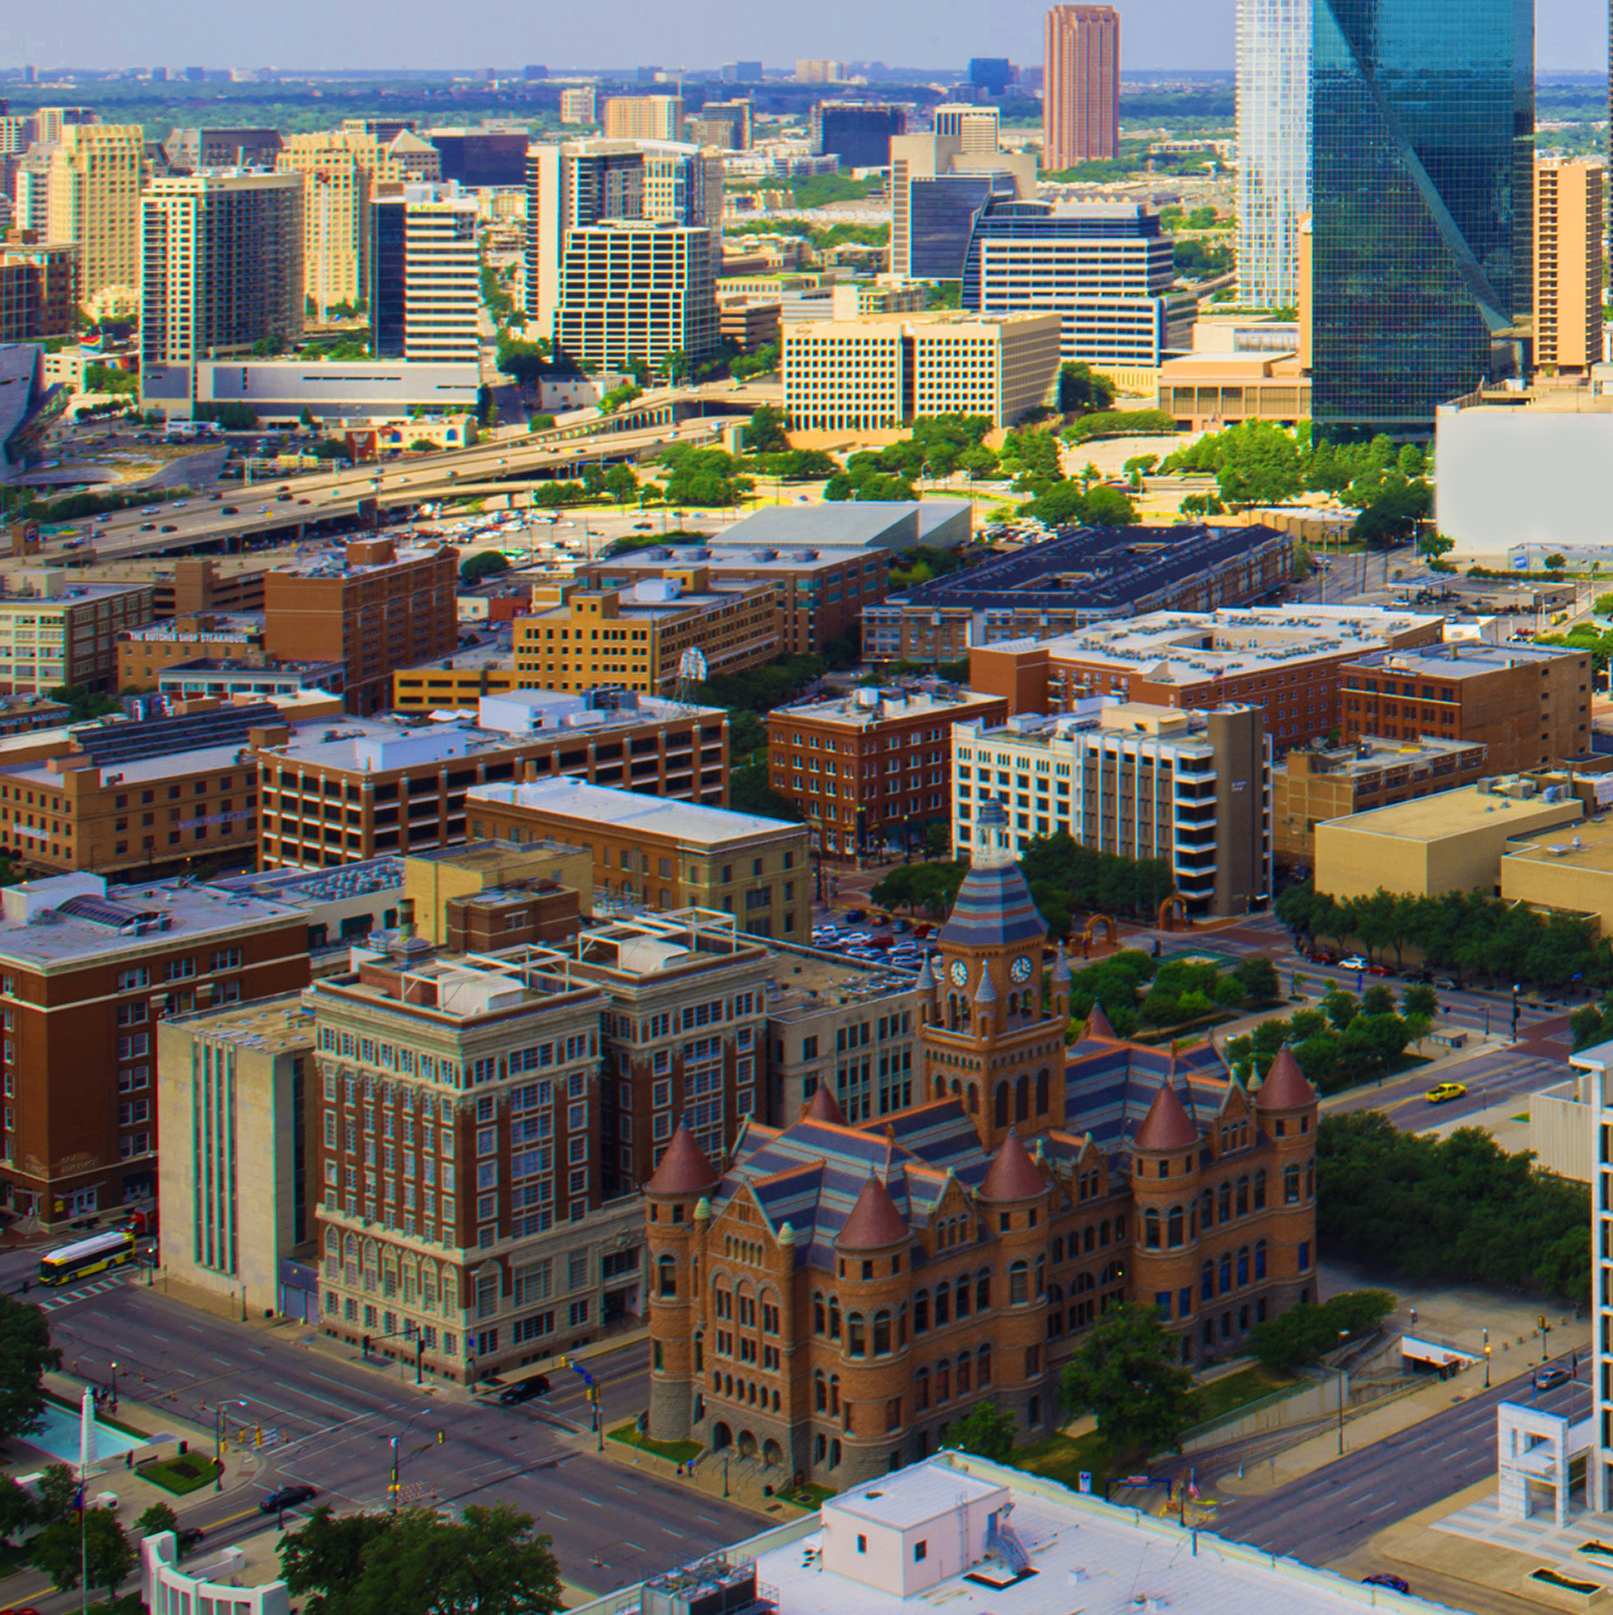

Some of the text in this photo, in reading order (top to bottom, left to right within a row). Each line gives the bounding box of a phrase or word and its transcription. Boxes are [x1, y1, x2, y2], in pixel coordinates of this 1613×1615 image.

[129, 632, 248, 644] THE BUTCHER SHOP STEAKHOUSE
